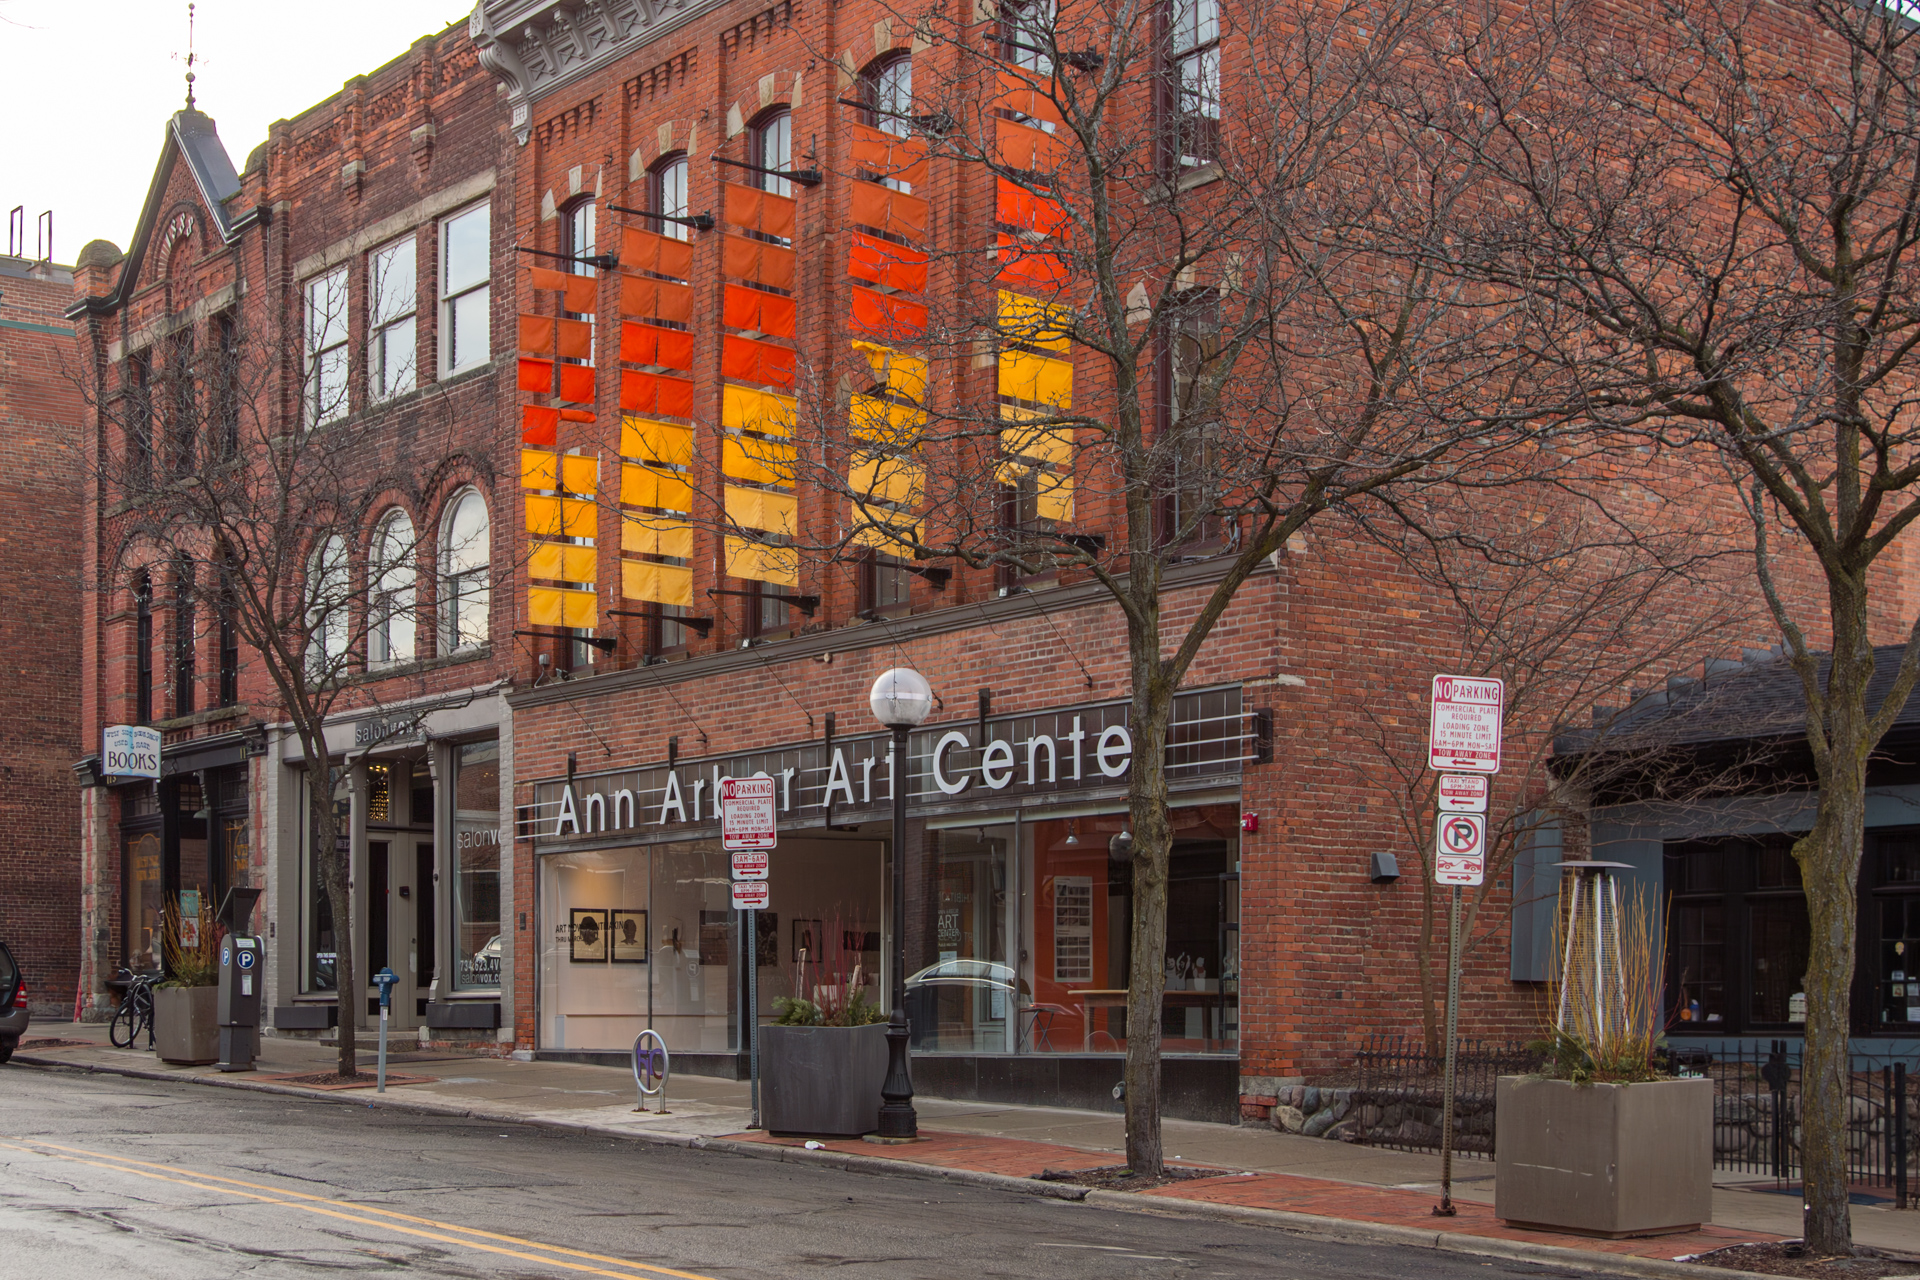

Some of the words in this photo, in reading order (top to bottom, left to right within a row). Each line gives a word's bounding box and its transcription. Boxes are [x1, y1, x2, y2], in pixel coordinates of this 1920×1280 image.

[1435, 681, 1451, 699] NO
[1454, 685, 1498, 700] PARKING
[1437, 704, 1476, 713] COMMERCIAL
[1480, 707, 1497, 715] PLATE
[1452, 713, 1482, 721] REQUIRED
[1443, 722, 1470, 730] LOADING
[1474, 724, 1489, 732] ZONE
[1435, 739, 1464, 748] 6AM-6PM
[1468, 742, 1495, 750] MON-SAT
[108, 751, 157, 770] BOOKS
[555, 785, 635, 836] Ann
[660, 764, 796, 825] Arbr
[933, 716, 1132, 794] Cente
[723, 784, 736, 797] NO
[737, 783, 770, 794] PARKING
[938, 914, 959, 928] ART
[555, 924, 566, 933] ART
[938, 928, 959, 937] CENTER
[224, 950, 229, 964] P
[242, 953, 251, 965] P
